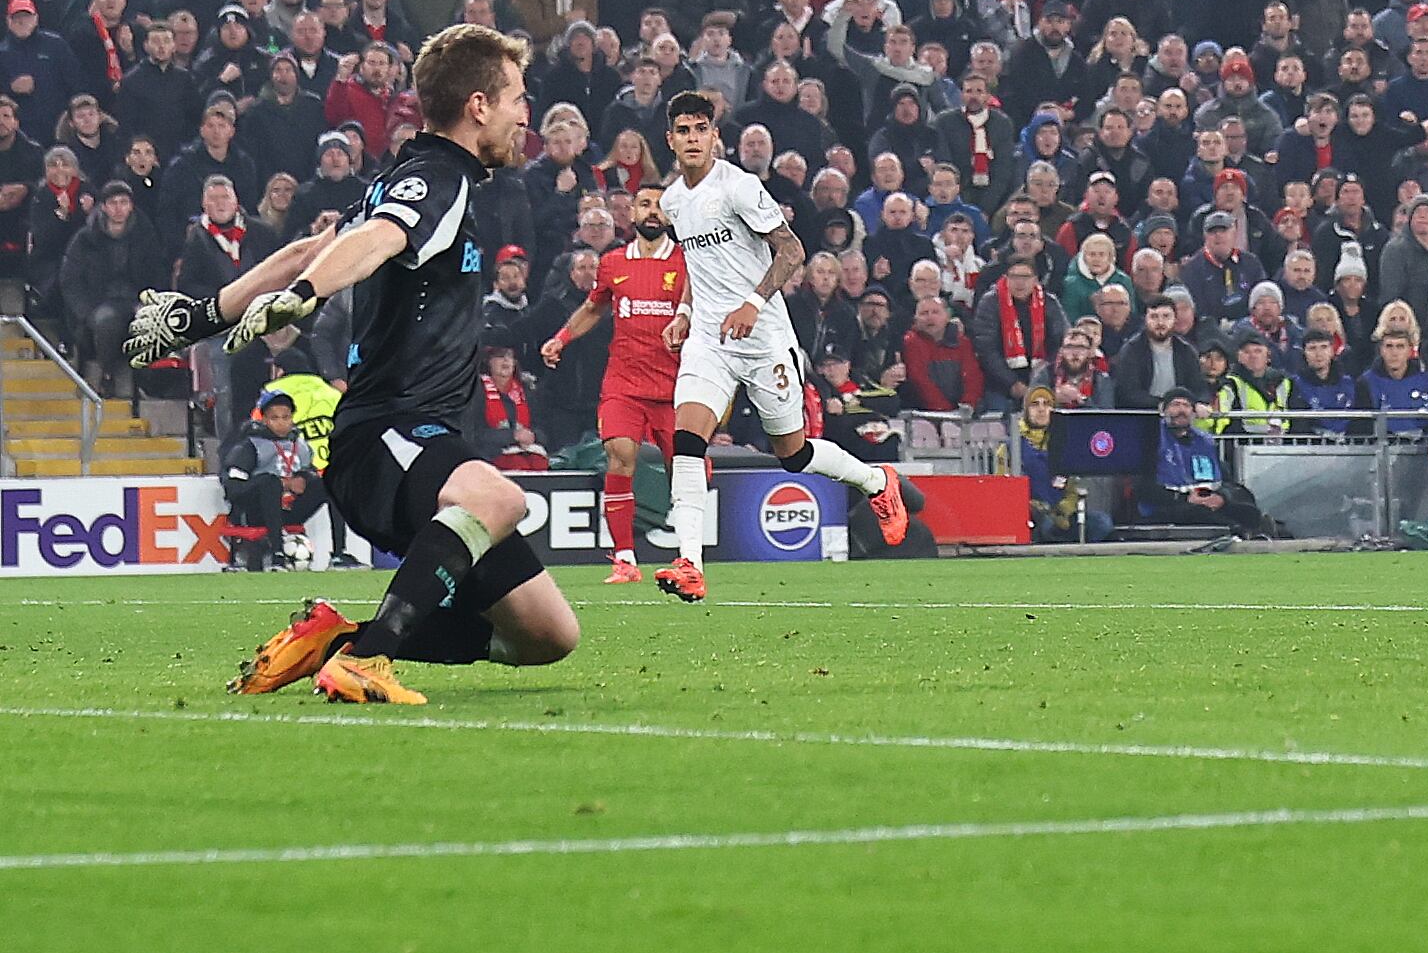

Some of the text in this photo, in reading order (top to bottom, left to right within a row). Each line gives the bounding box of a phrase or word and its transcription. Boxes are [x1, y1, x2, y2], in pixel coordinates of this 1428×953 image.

[773, 364, 789, 390] 3
[1, 486, 231, 568] FedEx
[515, 489, 718, 549] PEI
[765, 510, 814, 522] PEPSI
